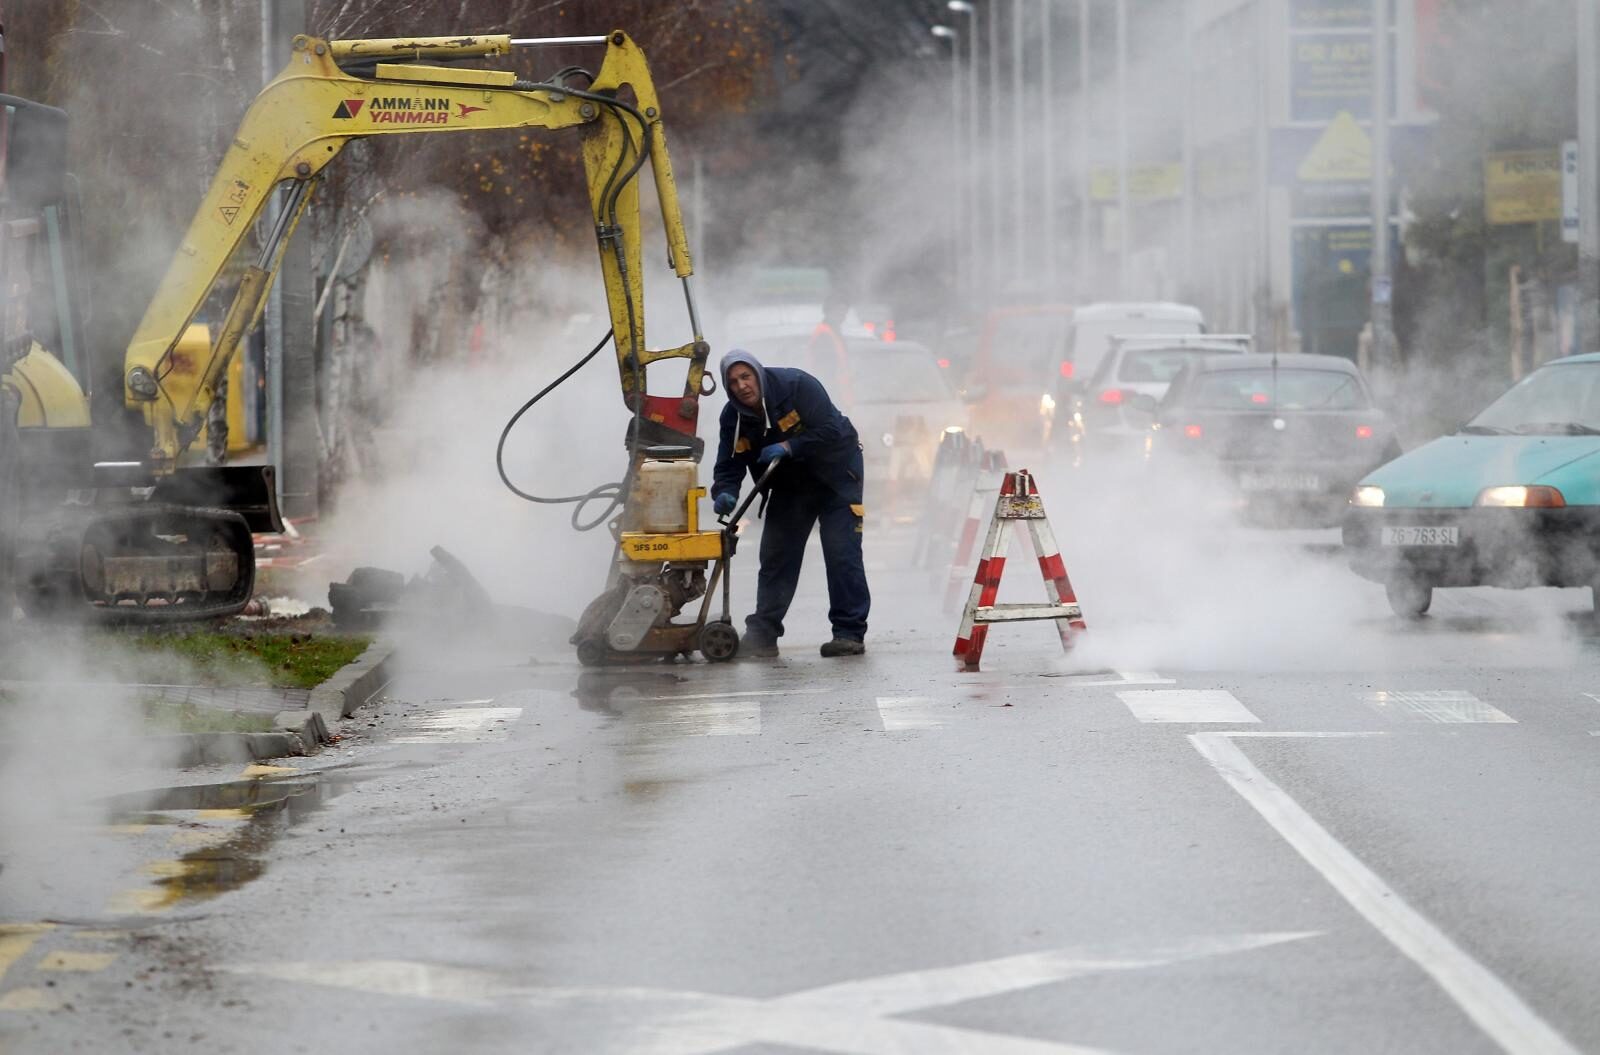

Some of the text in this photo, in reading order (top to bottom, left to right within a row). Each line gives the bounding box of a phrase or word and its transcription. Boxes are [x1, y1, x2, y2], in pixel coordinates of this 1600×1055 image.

[370, 98, 449, 110] AMMANN
[370, 111, 449, 123] YANMAR
[652, 543, 668, 551] 100
